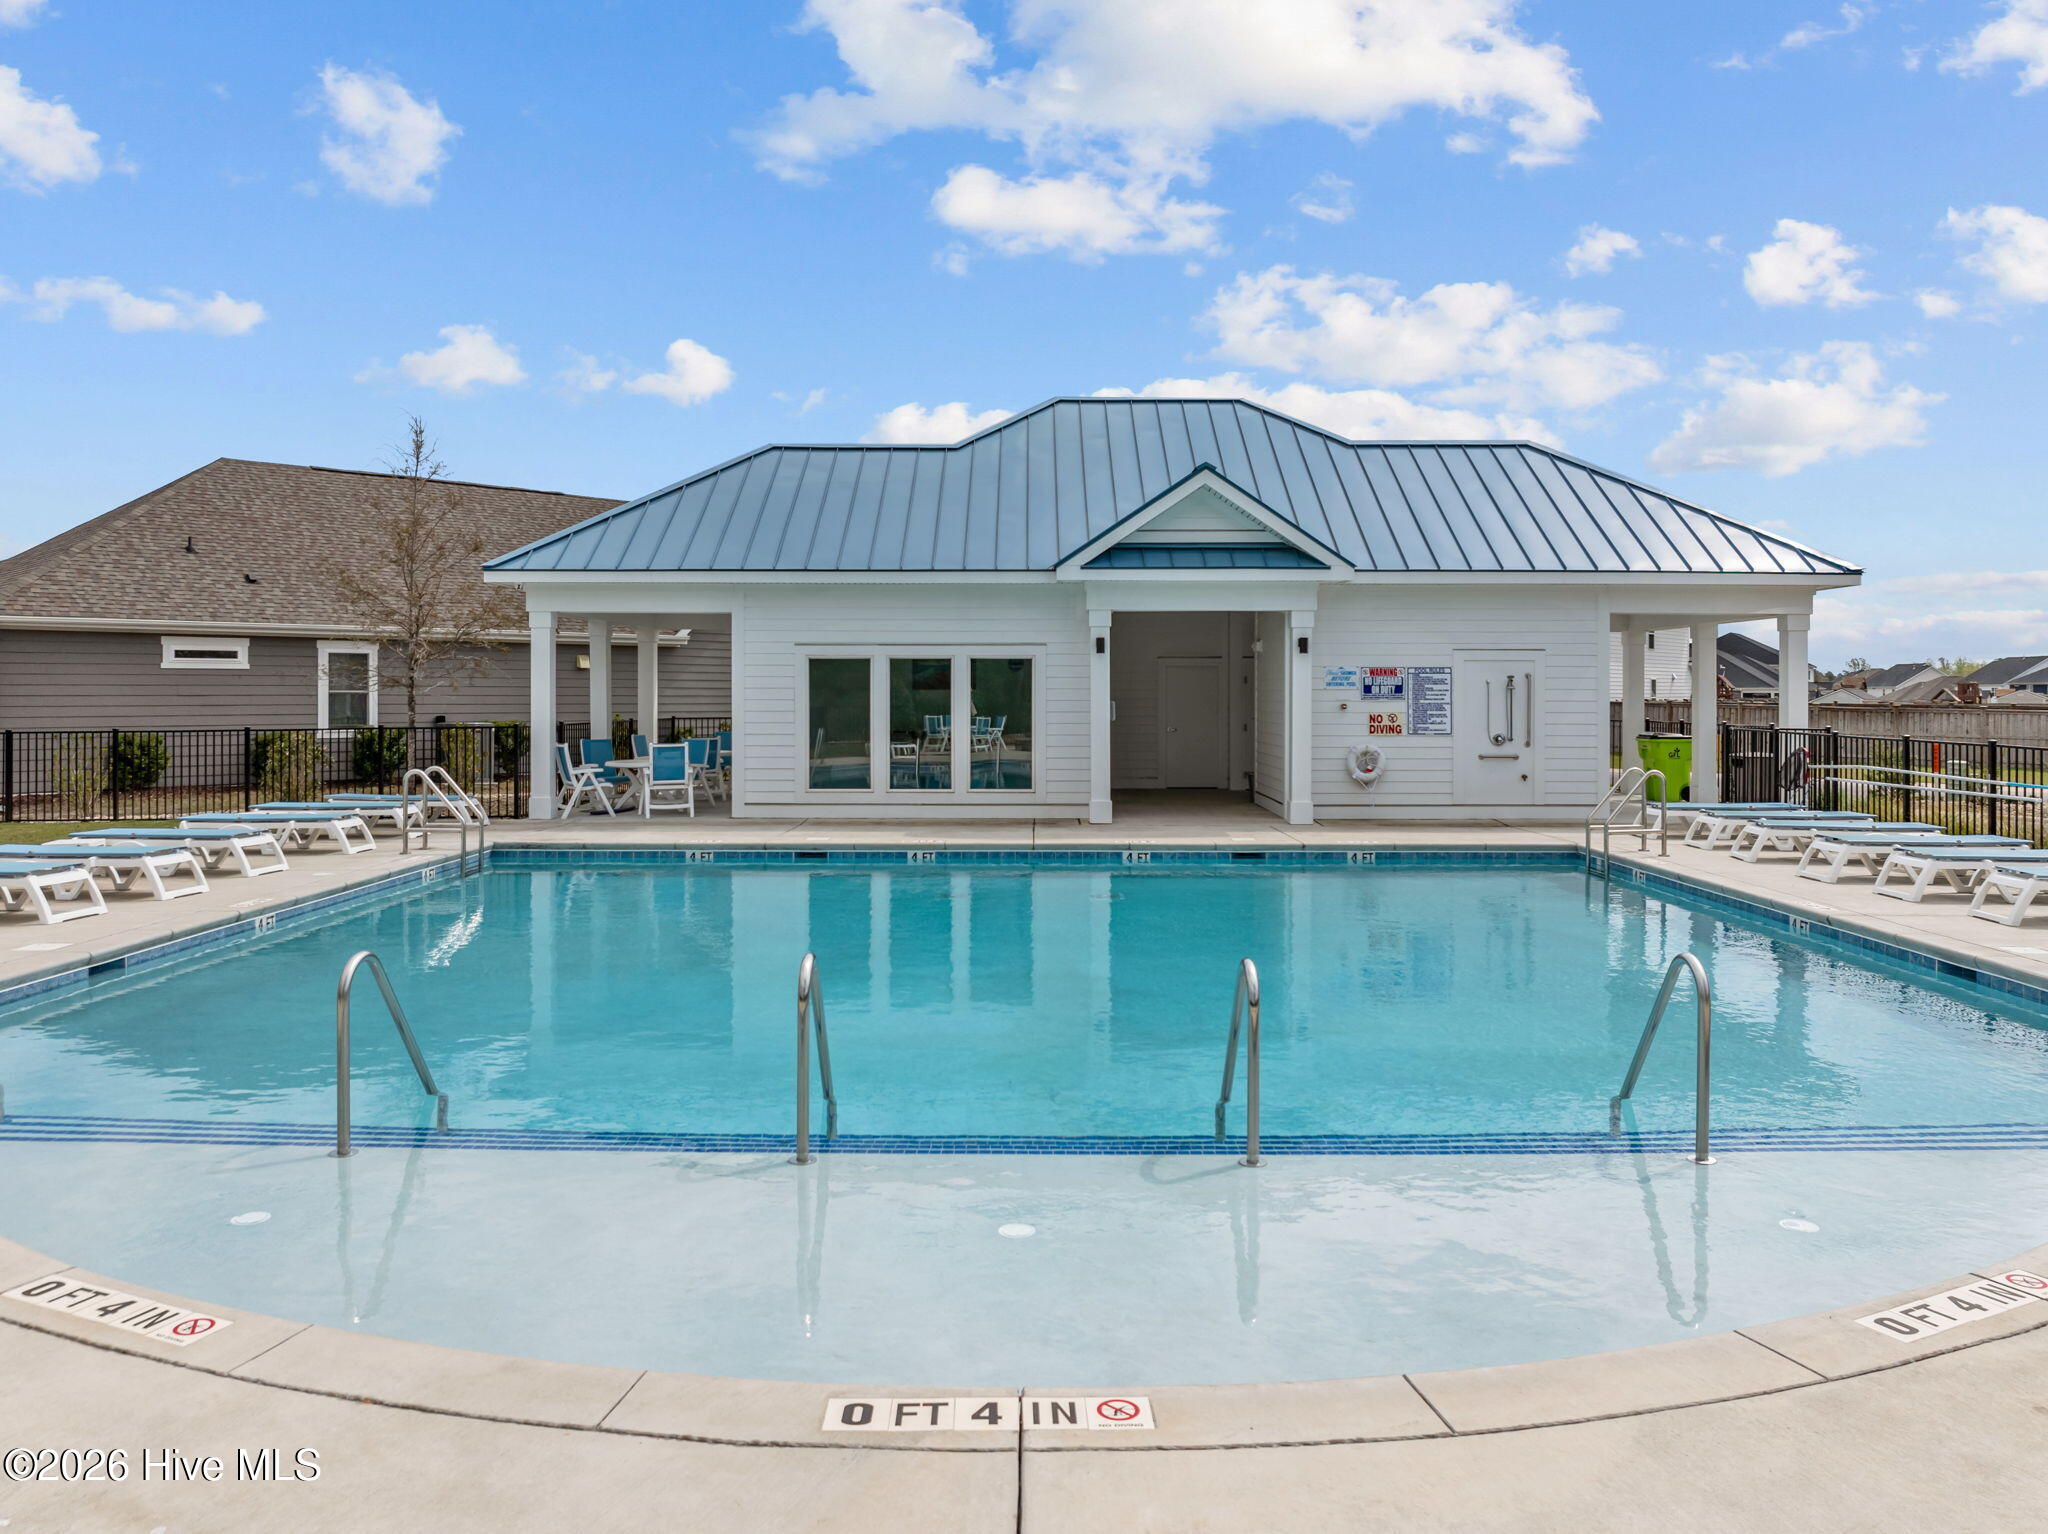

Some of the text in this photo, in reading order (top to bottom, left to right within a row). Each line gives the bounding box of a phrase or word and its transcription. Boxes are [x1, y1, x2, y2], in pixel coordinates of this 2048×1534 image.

[1369, 668, 1398, 676] WARNING
[1364, 677, 1402, 685] NO LIFEGUARD
[1371, 686, 1396, 694] ON DUTY
[1369, 714, 1383, 723] NO
[1369, 725, 1402, 734] DIVING
[48, 1288, 109, 1308] FT
[96, 1300, 136, 1317] 4
[122, 1307, 180, 1329] IN
[1900, 1304, 1957, 1327] FT
[1947, 1296, 1989, 1312] 4
[1969, 1284, 2027, 1304] IN
[895, 1402, 949, 1426] FT
[971, 1402, 1003, 1425] 4
[1032, 1402, 1078, 1425] IN
